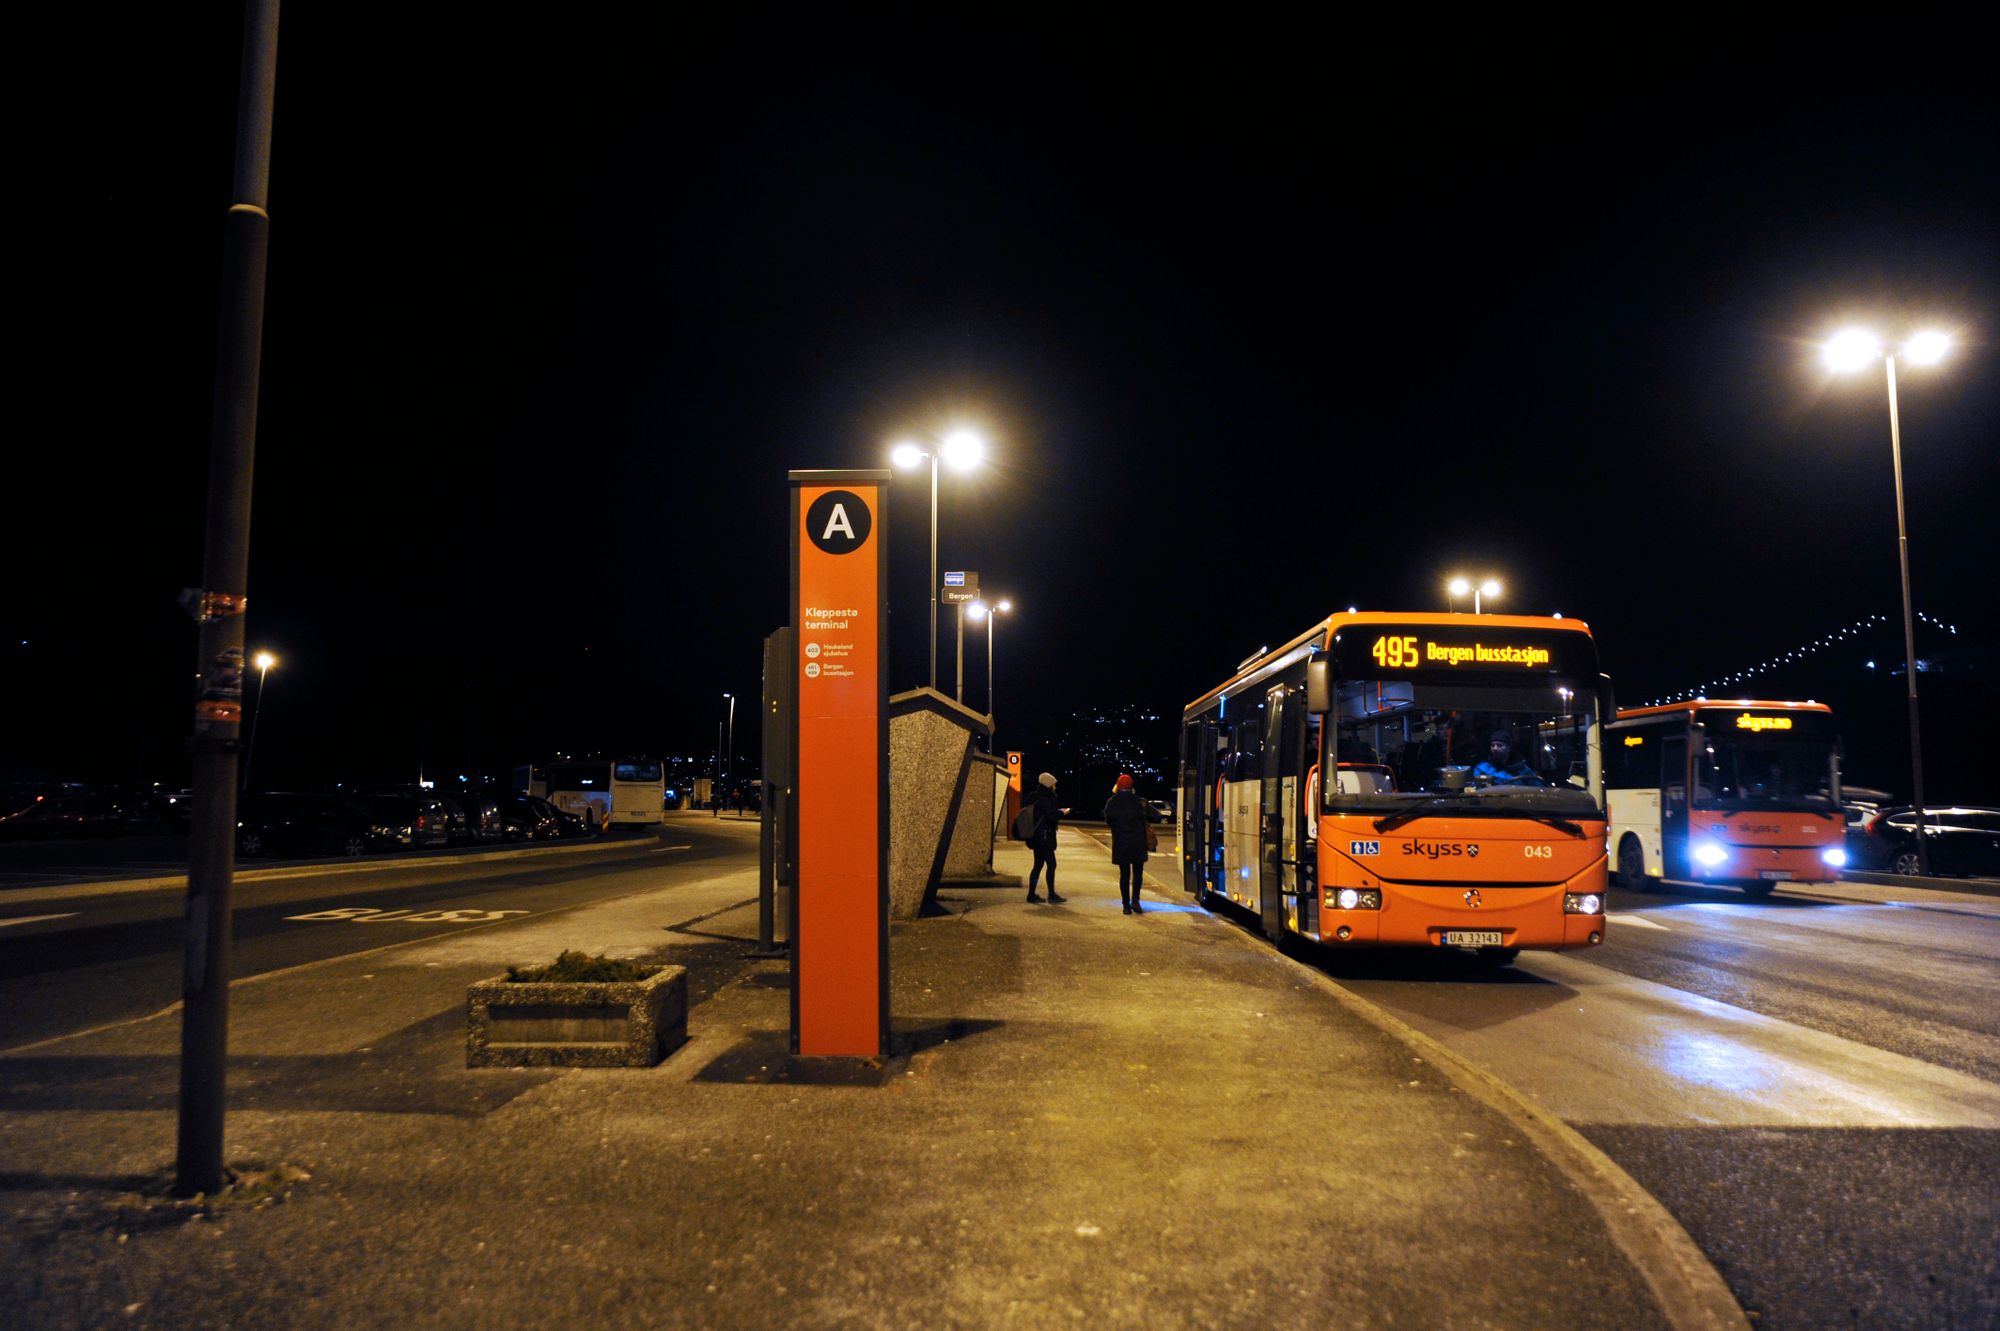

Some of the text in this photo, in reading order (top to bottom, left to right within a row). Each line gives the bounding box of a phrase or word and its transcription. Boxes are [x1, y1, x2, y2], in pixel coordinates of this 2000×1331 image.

[822, 503, 855, 539] A
[948, 592, 974, 601] Bergen
[805, 619, 849, 630] terminal
[1372, 635, 1550, 668] 495 Bergen busstasjon
[1402, 838, 1463, 859] skyss
[1524, 845, 1553, 859] 043
[283, 907, 531, 922] BUSS
[1450, 932, 1499, 944] UA 32143
